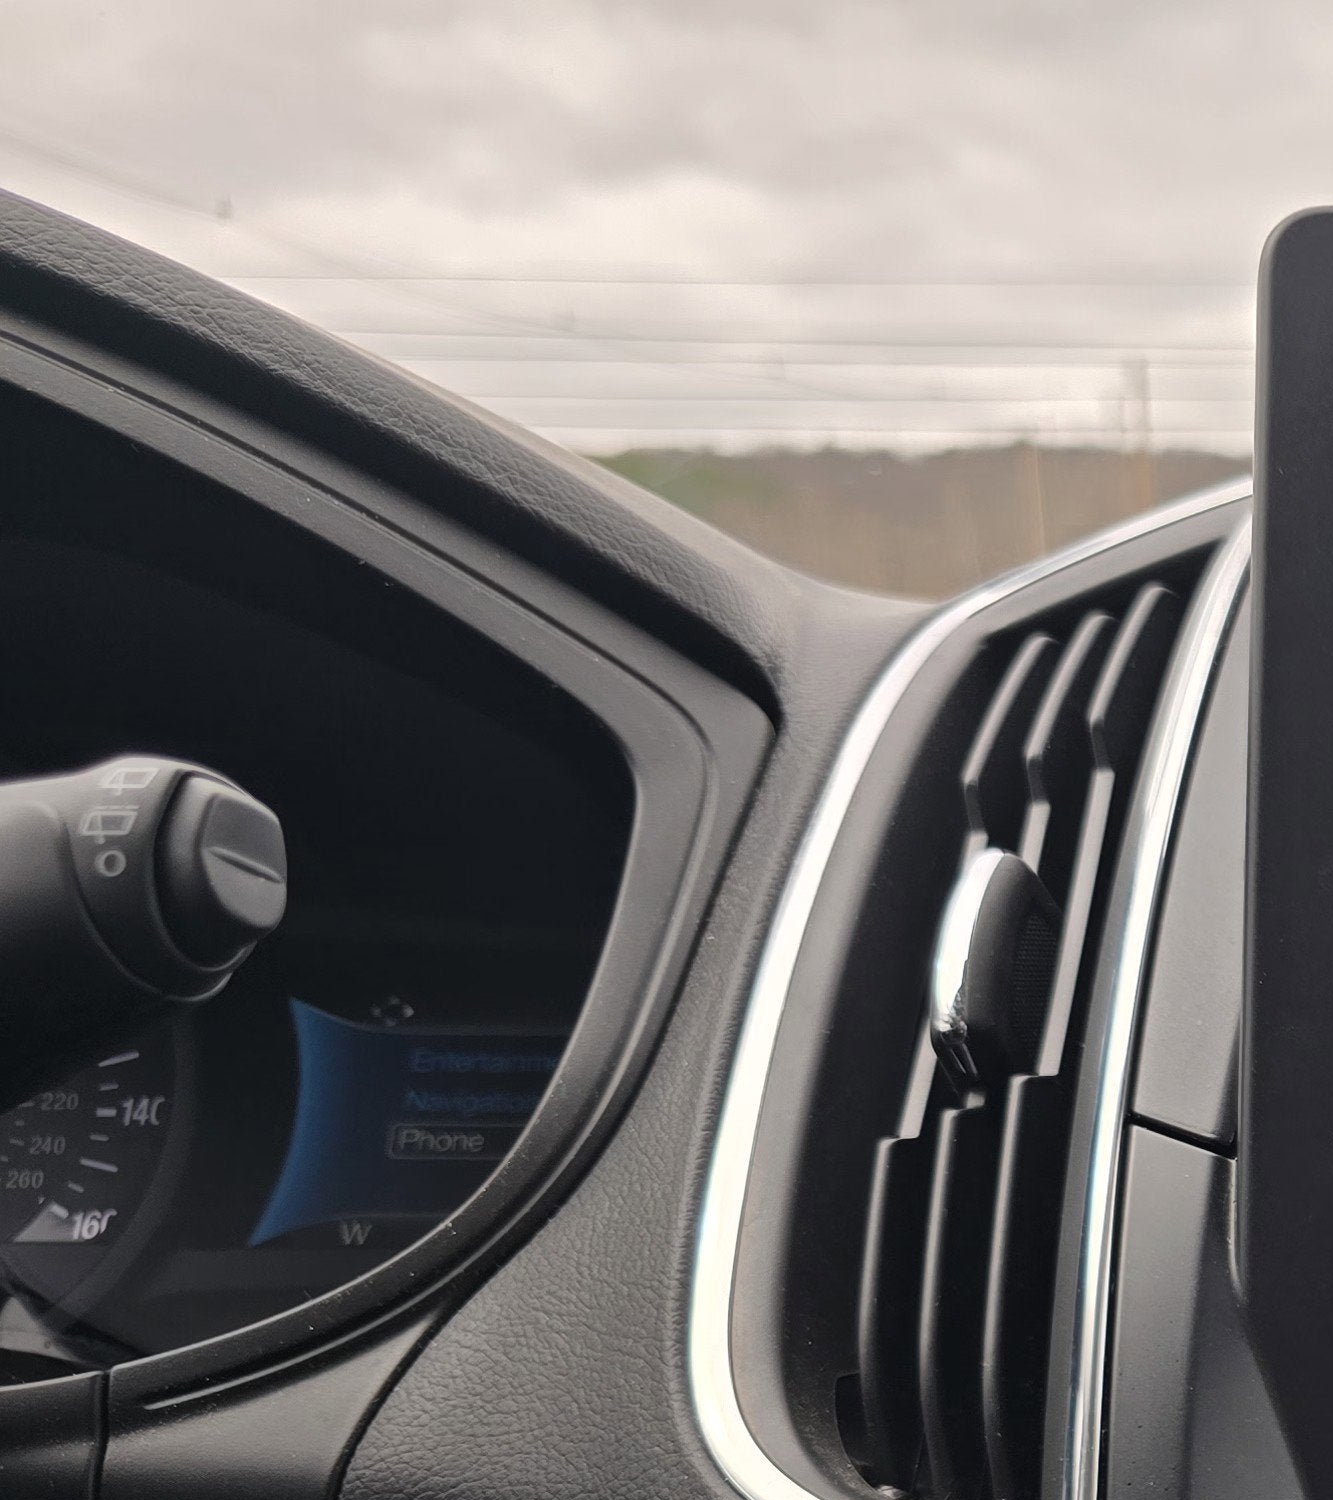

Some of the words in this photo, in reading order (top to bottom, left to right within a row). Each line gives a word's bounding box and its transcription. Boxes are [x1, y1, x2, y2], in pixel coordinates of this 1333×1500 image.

[40, 1091, 79, 1110] 220
[30, 1135, 66, 1155] 240
[399, 1128, 486, 1153] Phone
[338, 1219, 373, 1246] W
